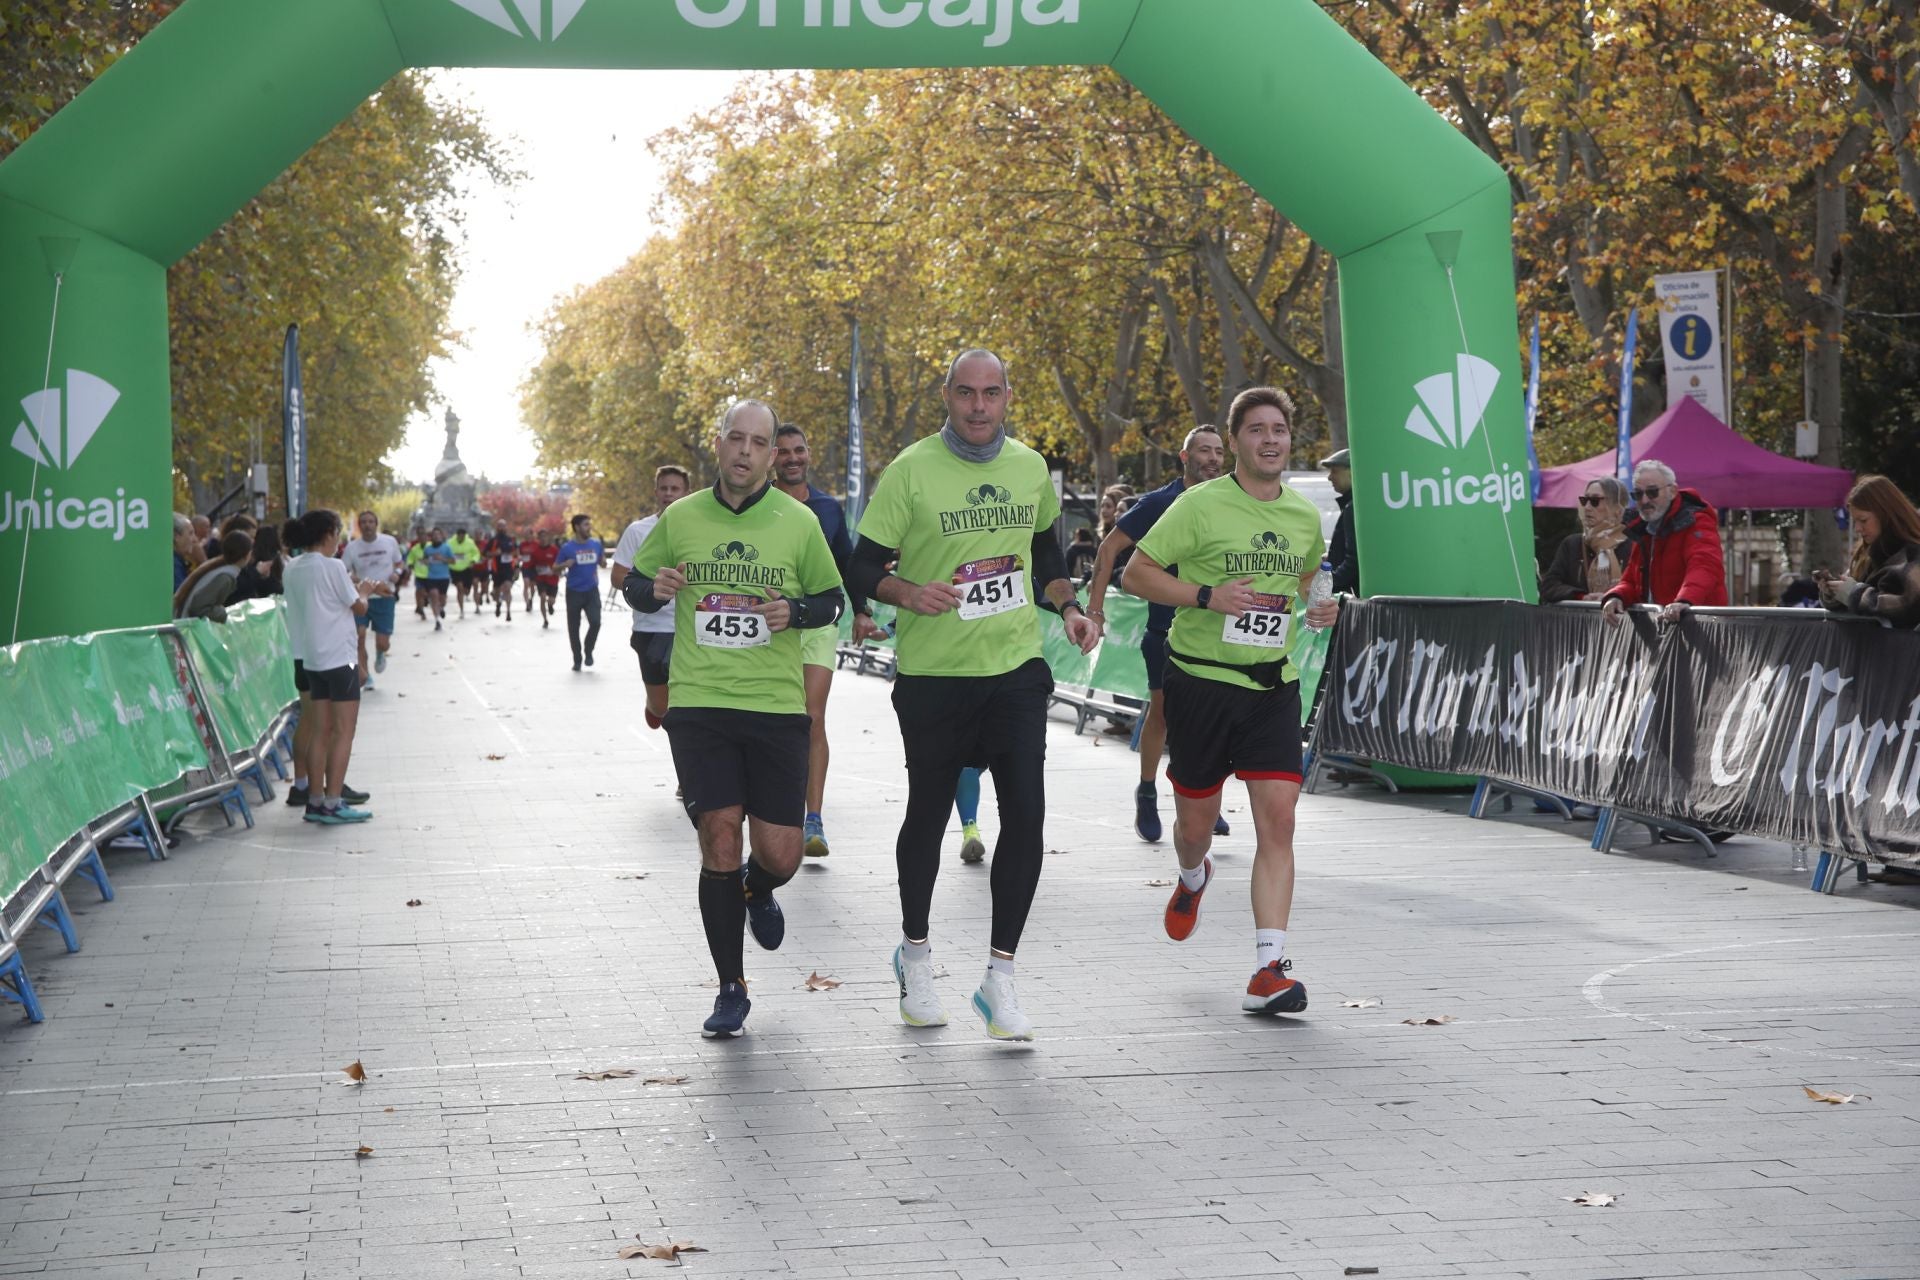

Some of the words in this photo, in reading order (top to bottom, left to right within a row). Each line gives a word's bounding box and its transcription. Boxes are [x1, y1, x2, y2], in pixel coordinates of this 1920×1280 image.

[1382, 462, 1526, 513] Unicaja
[938, 504, 1035, 533] ENTREPINARES
[686, 562, 786, 587] ENTREPINARES
[1224, 552, 1305, 573] ENTREPINARE
[967, 576, 1013, 606] 451
[705, 615, 759, 638] 453
[1234, 612, 1282, 637] 452
[1397, 638, 1500, 738] Norte
